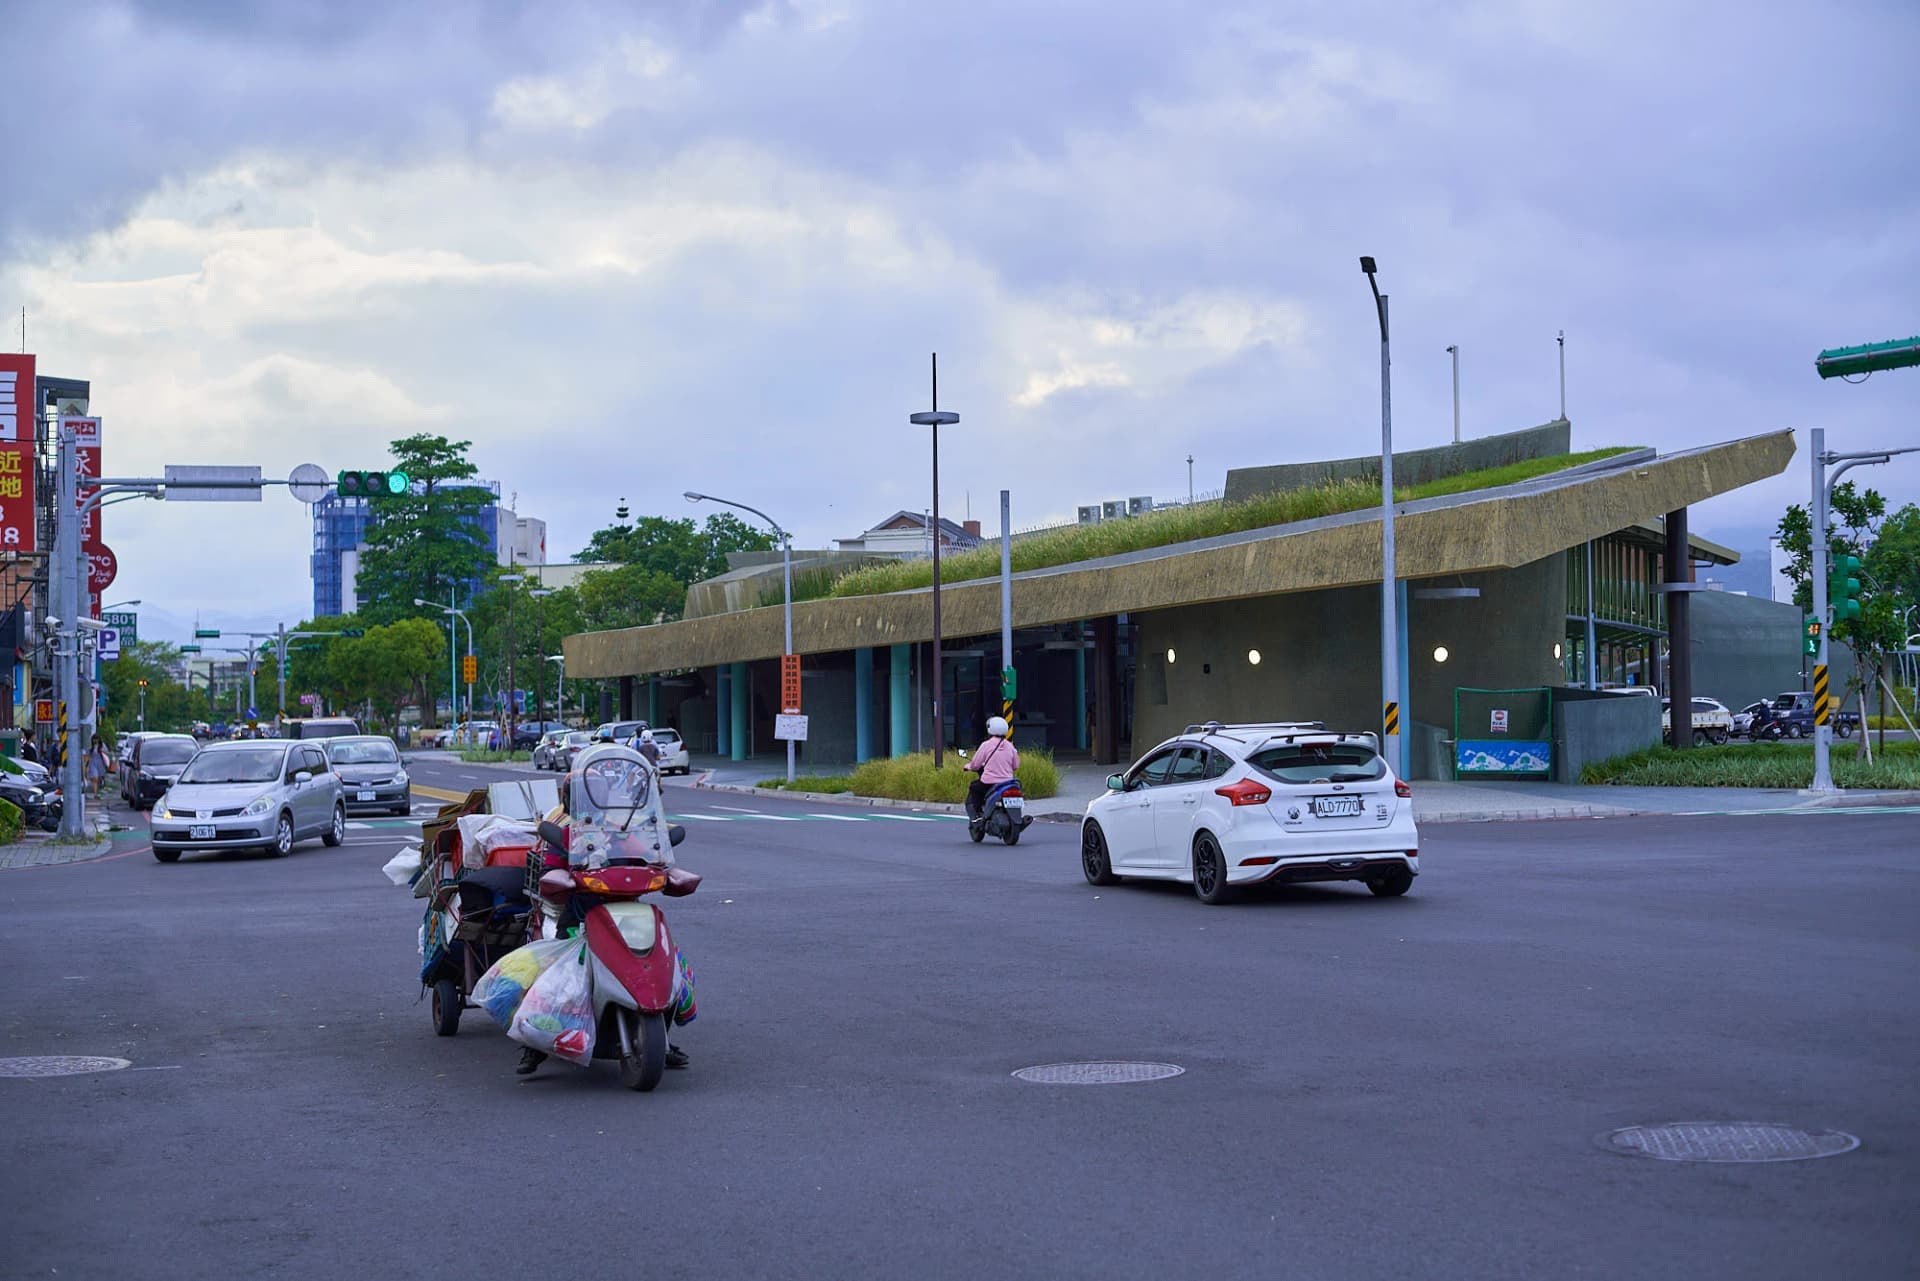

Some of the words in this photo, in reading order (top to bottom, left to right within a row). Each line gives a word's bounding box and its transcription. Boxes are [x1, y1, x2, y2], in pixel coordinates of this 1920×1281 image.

[0, 450, 22, 473] 近
[0, 476, 22, 498] 地
[99, 630, 116, 649] P
